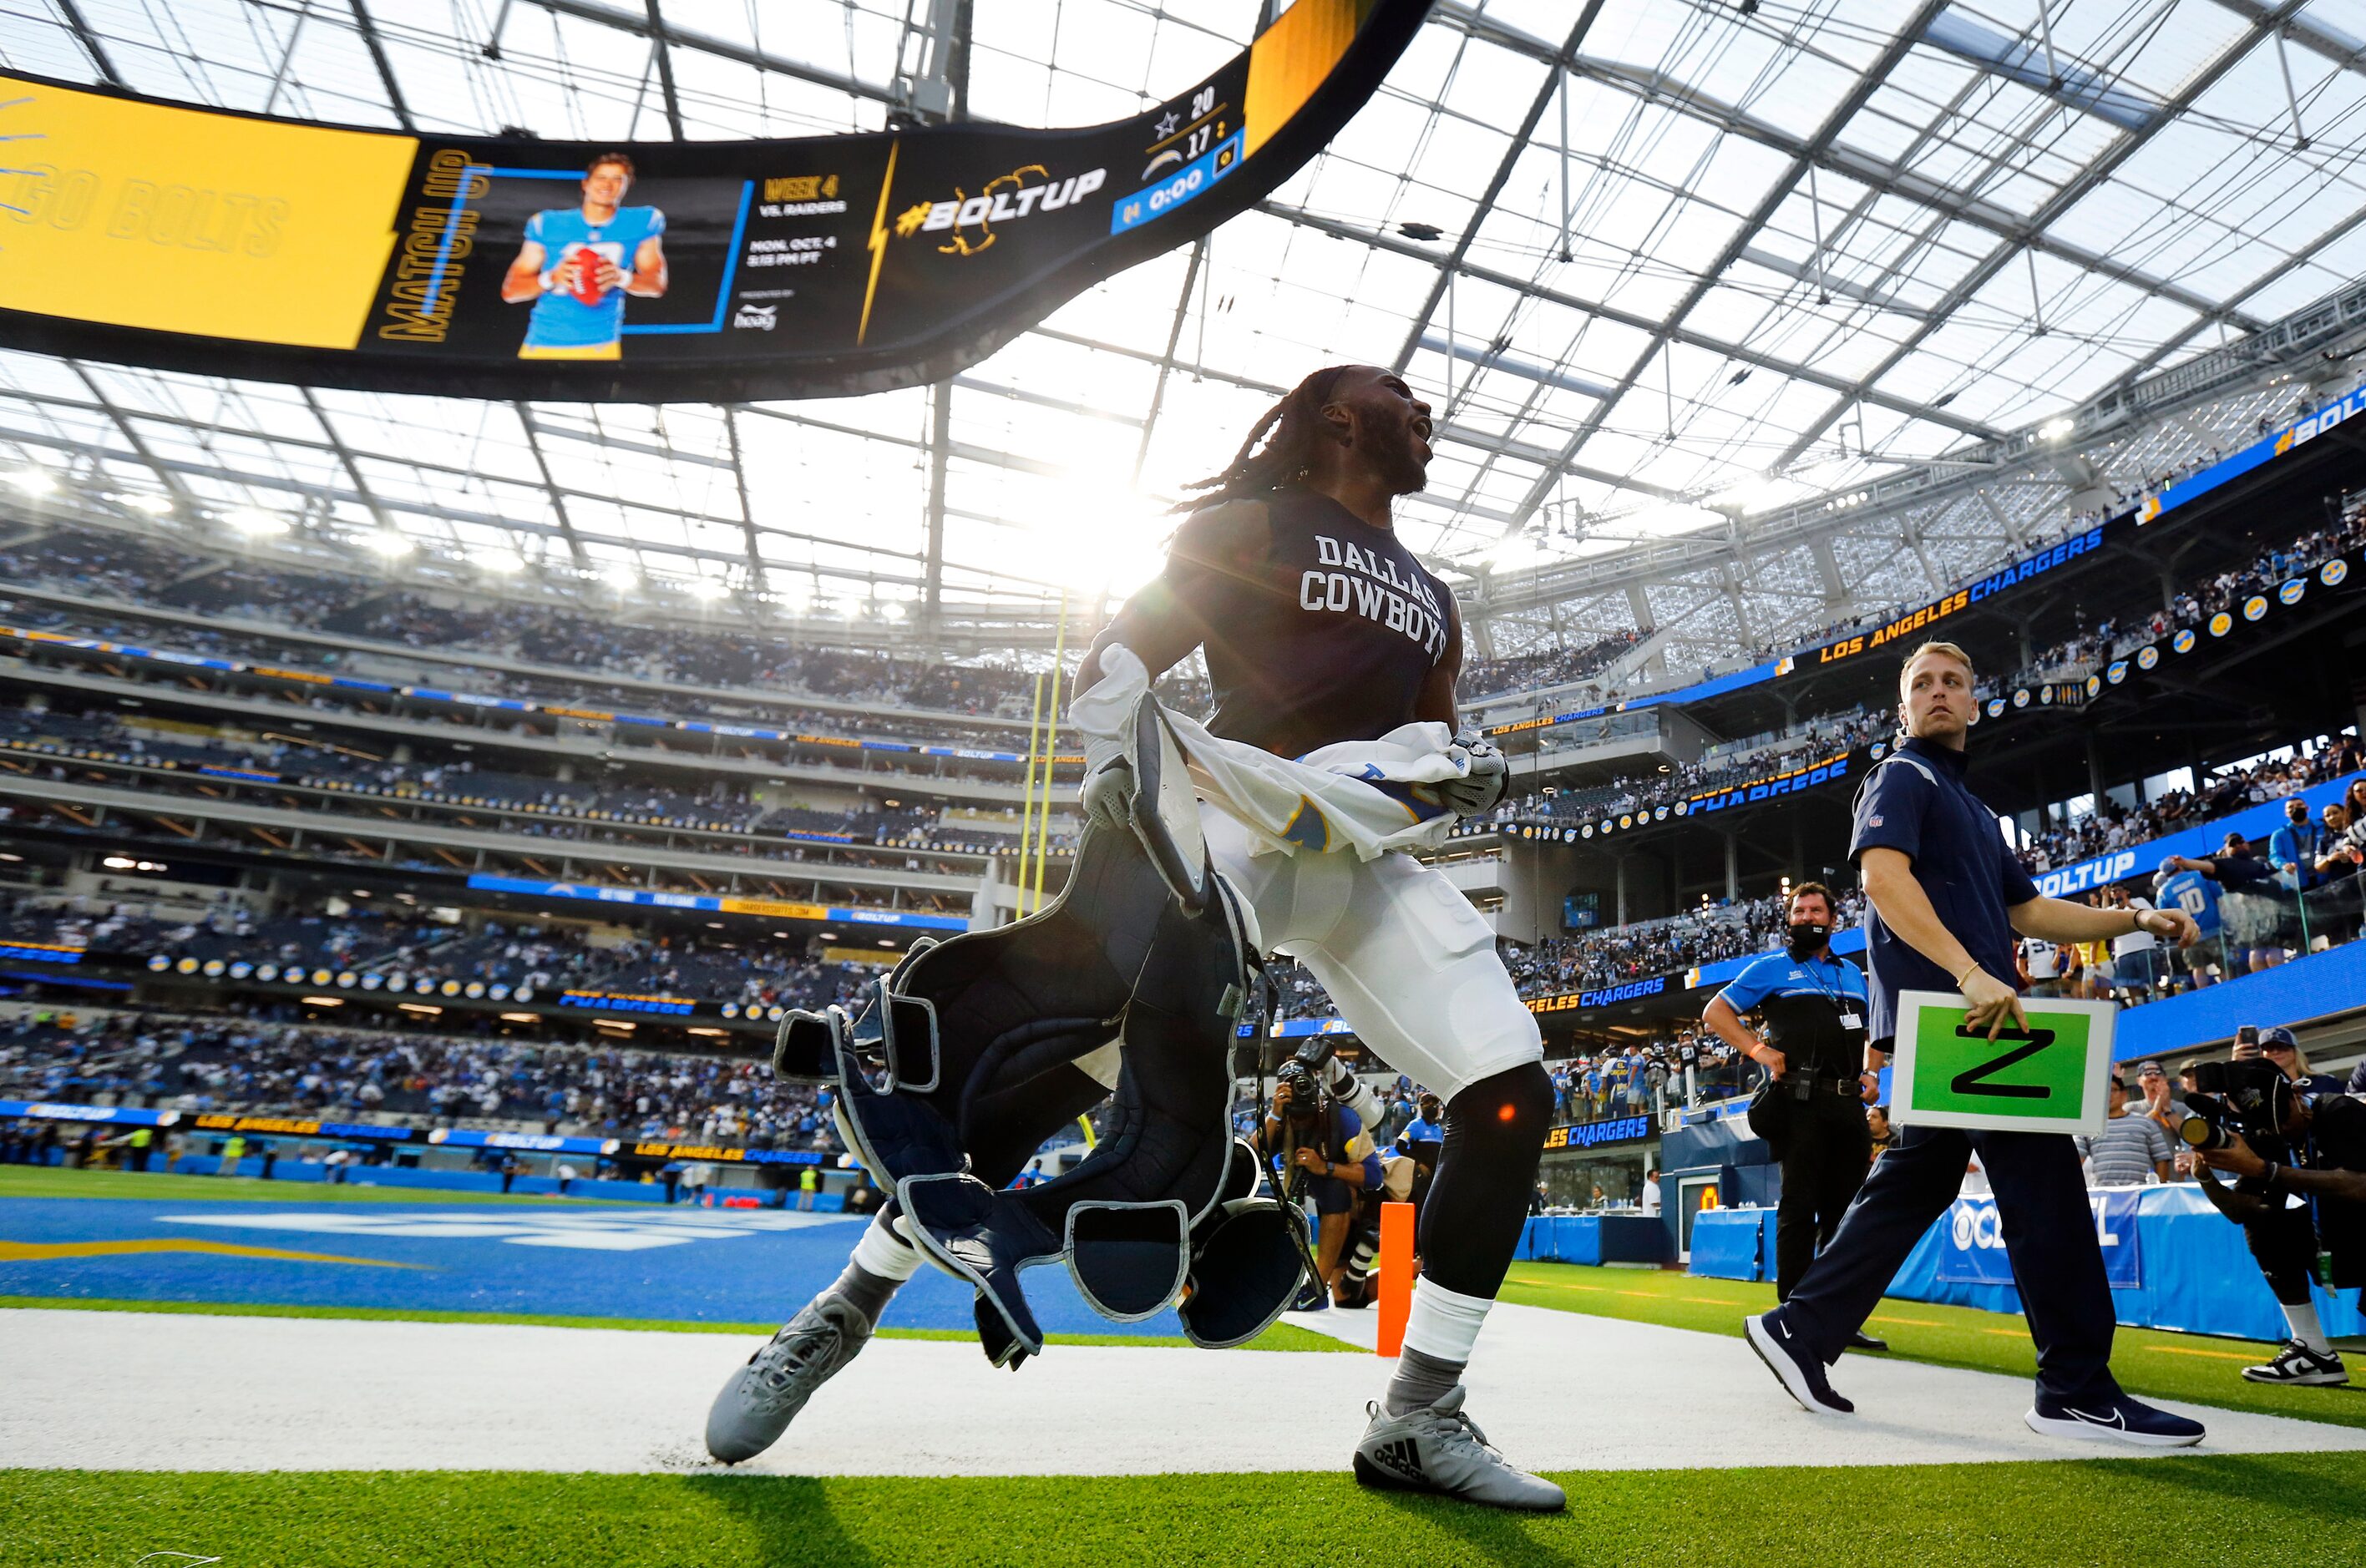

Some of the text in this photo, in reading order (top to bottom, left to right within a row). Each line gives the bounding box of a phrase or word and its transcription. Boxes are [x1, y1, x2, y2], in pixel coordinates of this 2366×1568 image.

[1191, 86, 1215, 120] 20
[1187, 124, 1210, 159] 17
[764, 175, 838, 202] WEEK 4
[894, 168, 1107, 238] #BOLTUP
[1149, 169, 1203, 210] 0:00
[379, 206, 479, 342] MATCH
[1315, 535, 1441, 620] DALLAS
[1821, 528, 2102, 663] LOS ANGELES CHARGERS
[1300, 570, 1446, 666] COWBOYS
[1492, 707, 1605, 735] LOS ANGELES CHARGERS
[1580, 977, 1664, 1006] CHARGERS
[1375, 1449, 1430, 1485] adidas
